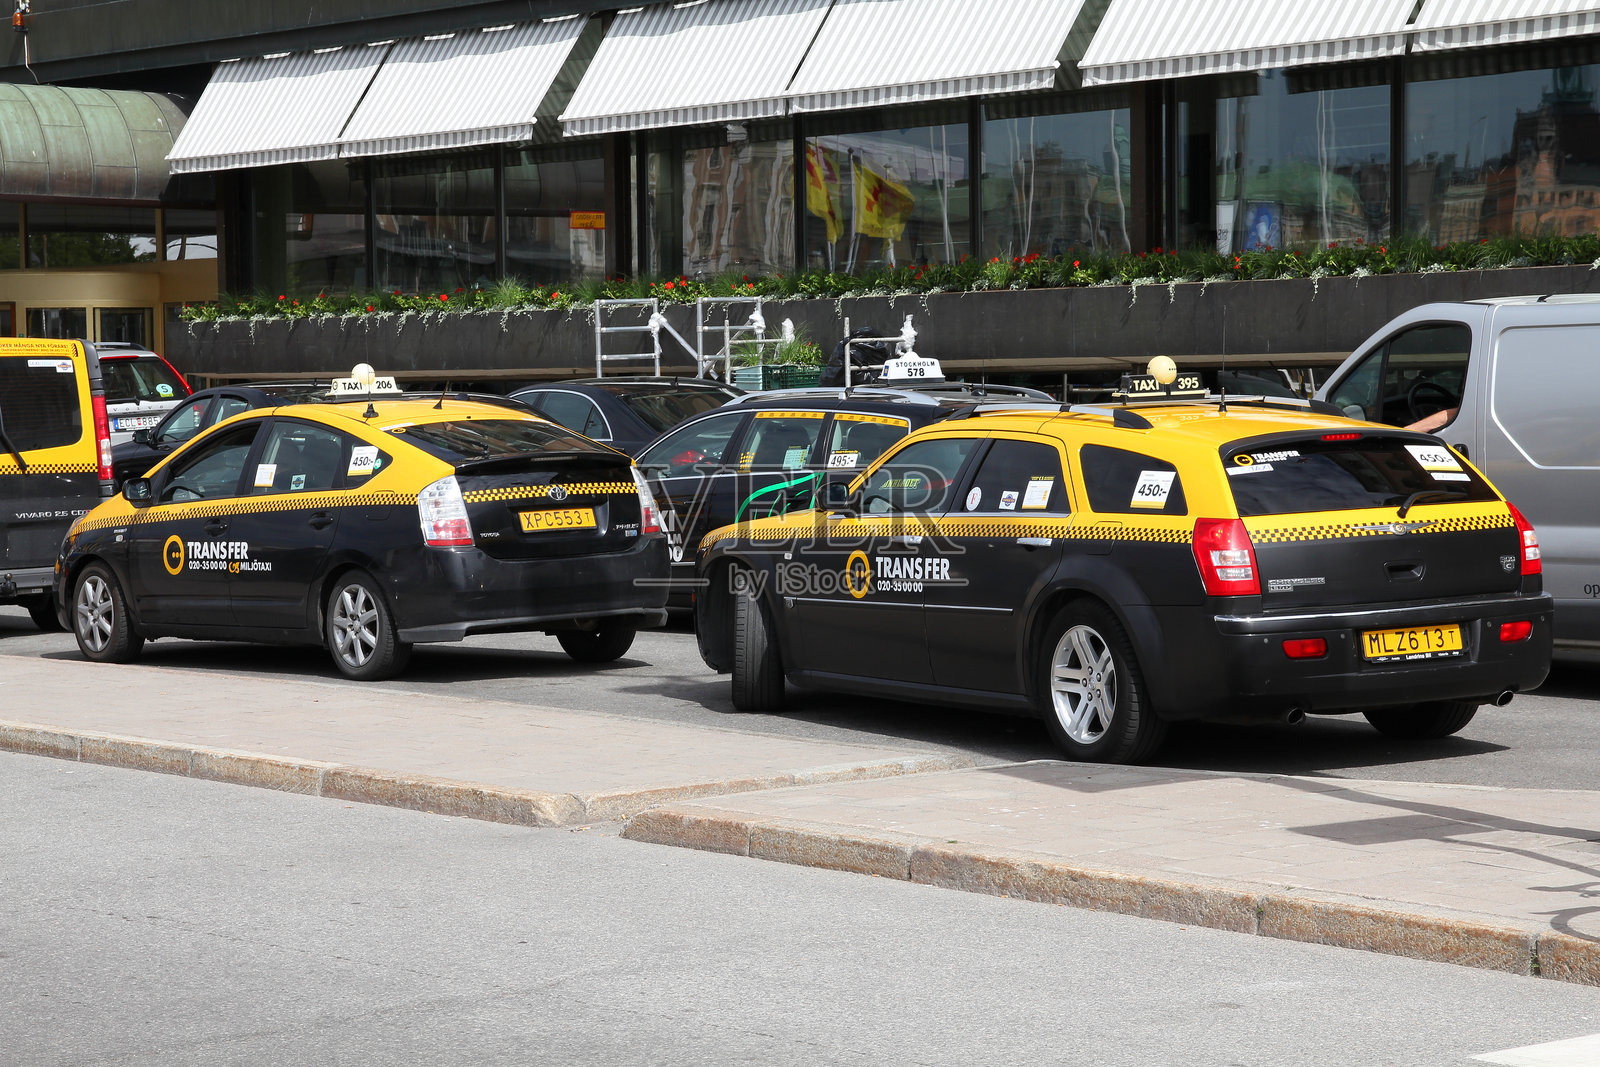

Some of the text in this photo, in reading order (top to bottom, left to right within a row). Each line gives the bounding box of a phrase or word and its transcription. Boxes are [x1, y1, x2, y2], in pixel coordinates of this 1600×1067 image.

[907, 367, 925, 377] 578
[342, 380, 393, 391] TAXI 206
[1133, 377, 1199, 391] TAXI 395
[120, 416, 159, 428] ECL 885
[1251, 450, 1300, 460] TRANSFER
[1138, 484, 1167, 497] 450:-
[15, 511, 53, 519] VIVARO
[523, 510, 583, 529] XPC553
[187, 541, 249, 560] TRANSFER
[240, 559, 272, 571] MILJÖTAXI
[876, 557, 951, 580] TRANSFER
[1368, 628, 1444, 654] MLZ613
